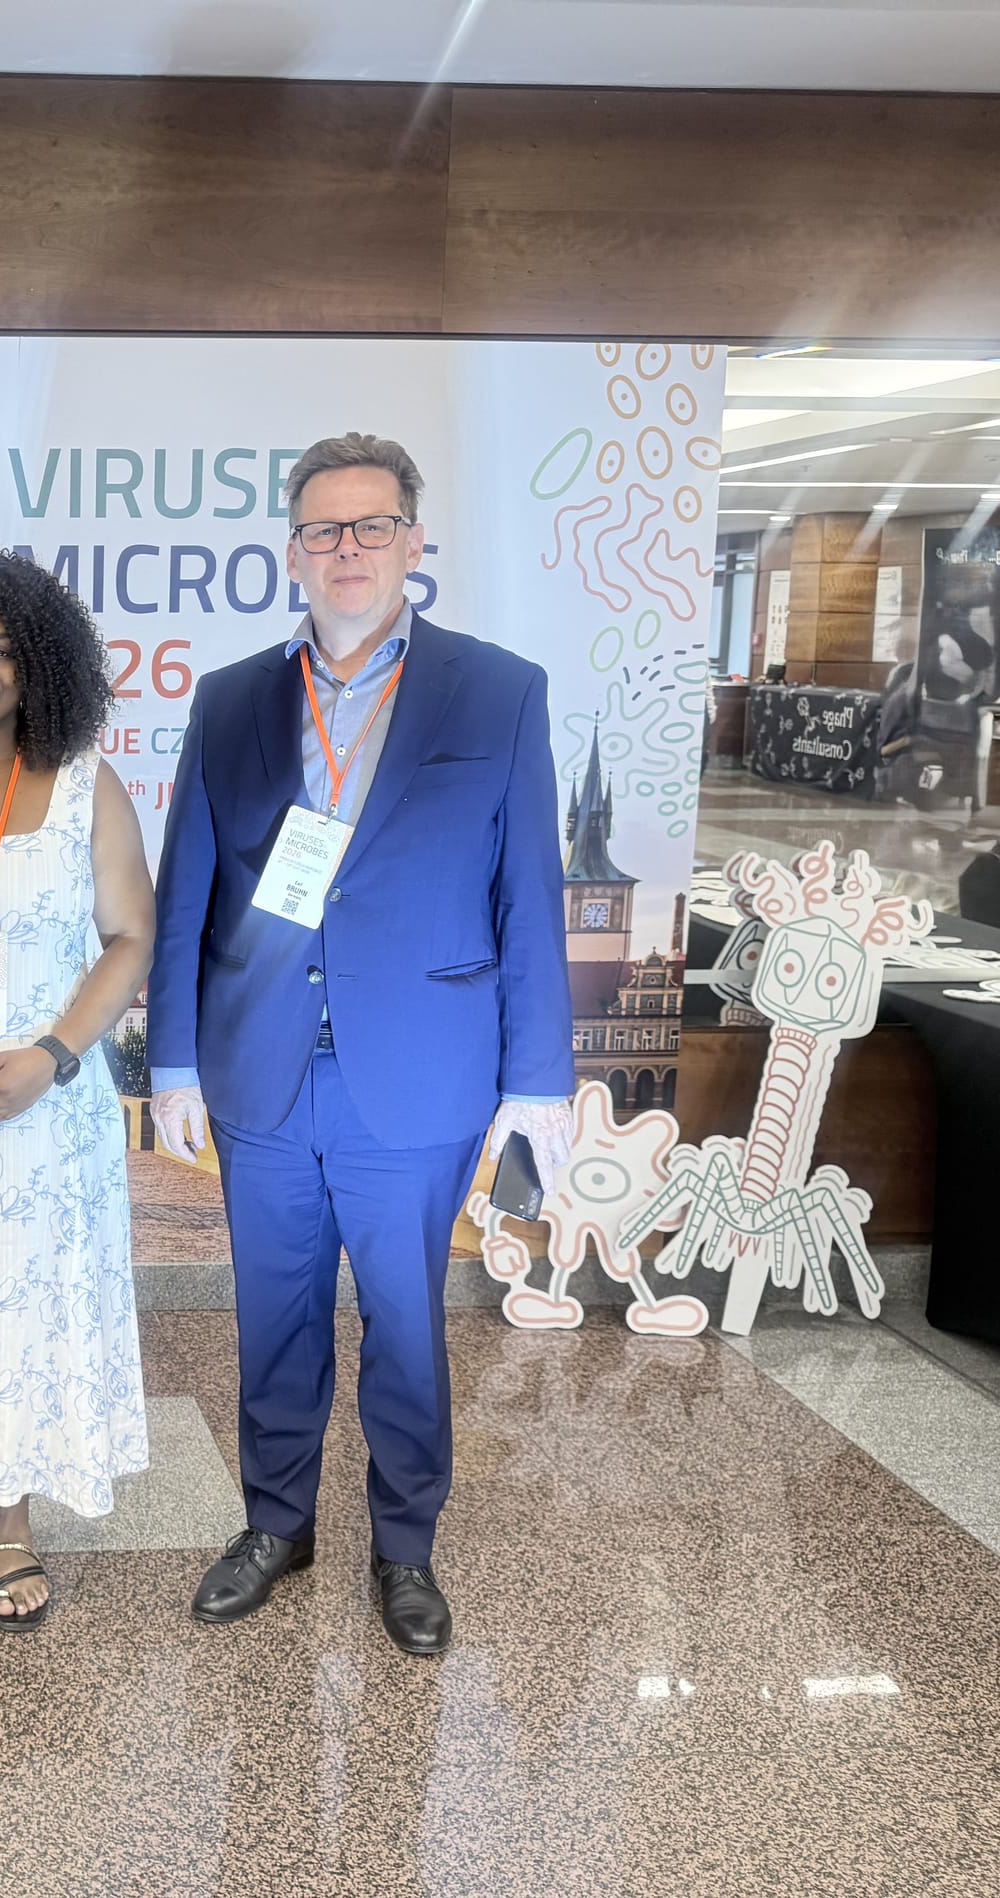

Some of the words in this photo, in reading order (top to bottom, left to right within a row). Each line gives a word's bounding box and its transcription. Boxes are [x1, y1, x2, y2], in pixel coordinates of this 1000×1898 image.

[8, 448, 310, 519] VIRUSE
[13, 544, 438, 614] MICROS
[107, 639, 192, 699] 26
[151, 728, 185, 754] CZ
[285, 837, 329, 860] MICROBES
[289, 829, 324, 848] VIRUSES
